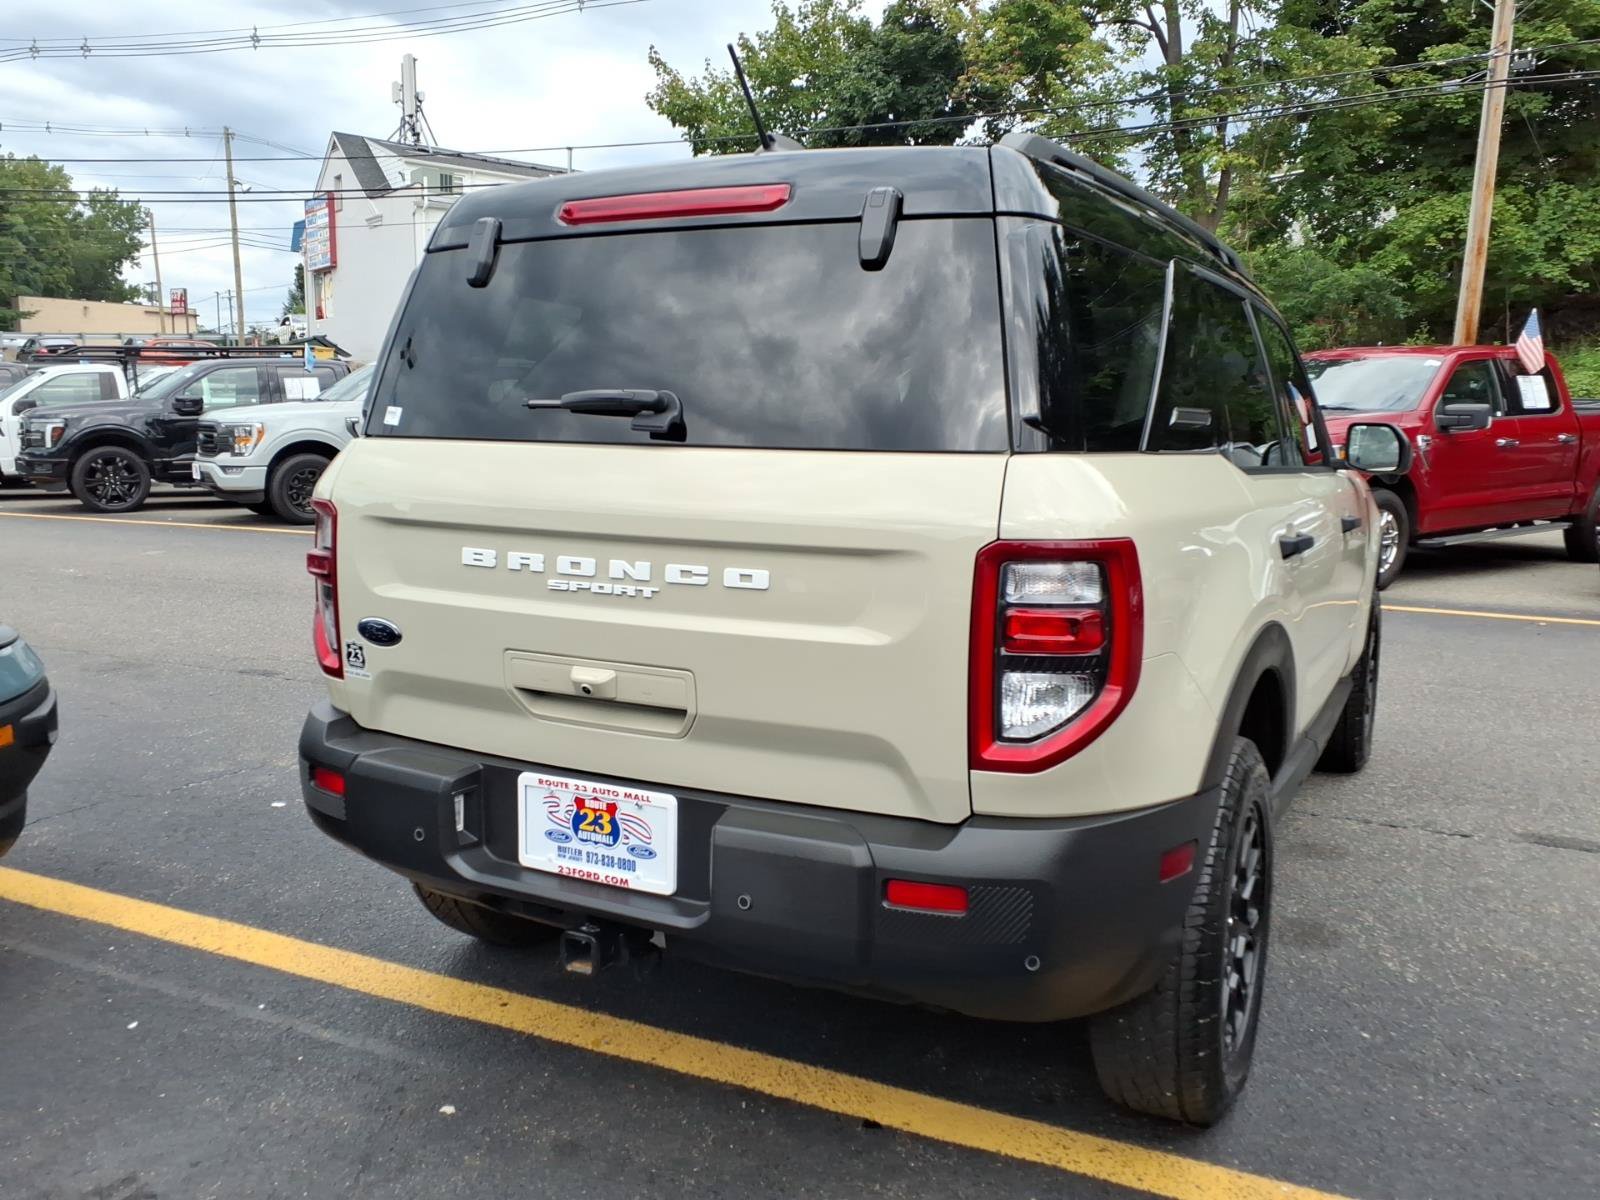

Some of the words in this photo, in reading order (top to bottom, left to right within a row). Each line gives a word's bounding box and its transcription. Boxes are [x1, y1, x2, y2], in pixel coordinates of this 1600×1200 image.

[461, 547, 769, 590] BRONCO
[547, 579, 660, 598] SPORT
[348, 648, 363, 662] 23
[538, 778, 569, 789] ROUTE
[574, 784, 588, 792] 23
[591, 787, 619, 797] AUTO
[623, 792, 651, 803] MALL
[584, 799, 608, 810] ROUTE
[579, 808, 612, 835] 23
[577, 830, 614, 845] AUTOMALL
[557, 845, 583, 857] BUTLER
[585, 851, 637, 873] 973-838-0800
[557, 865, 630, 887] 23FORD.COM
